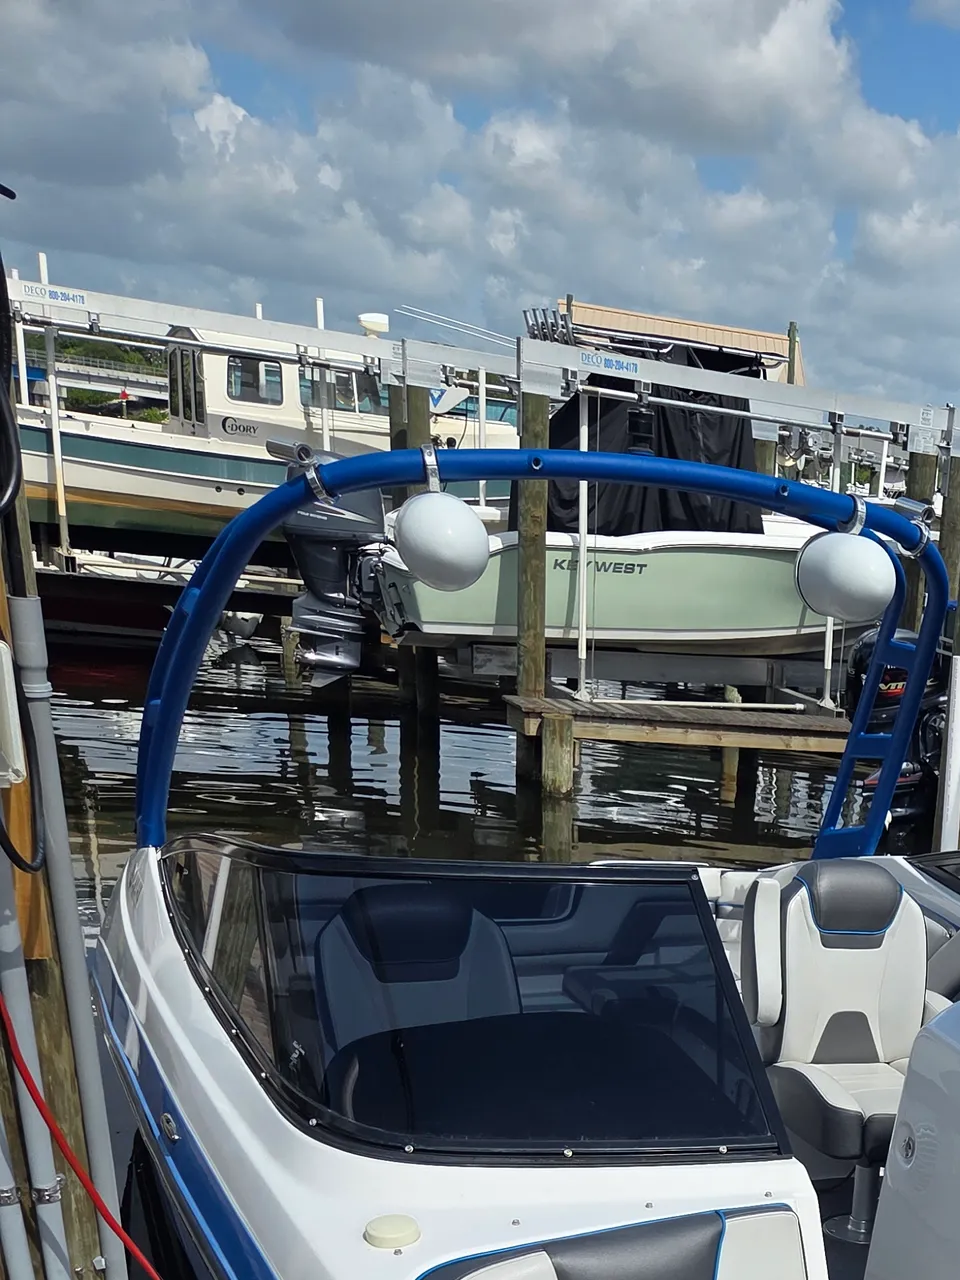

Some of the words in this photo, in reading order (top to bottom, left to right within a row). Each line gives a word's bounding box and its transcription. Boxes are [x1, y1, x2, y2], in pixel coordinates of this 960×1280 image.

[23, 284, 47, 297] DECO
[581, 352, 603, 365] DECO
[595, 561, 648, 575] WEST
